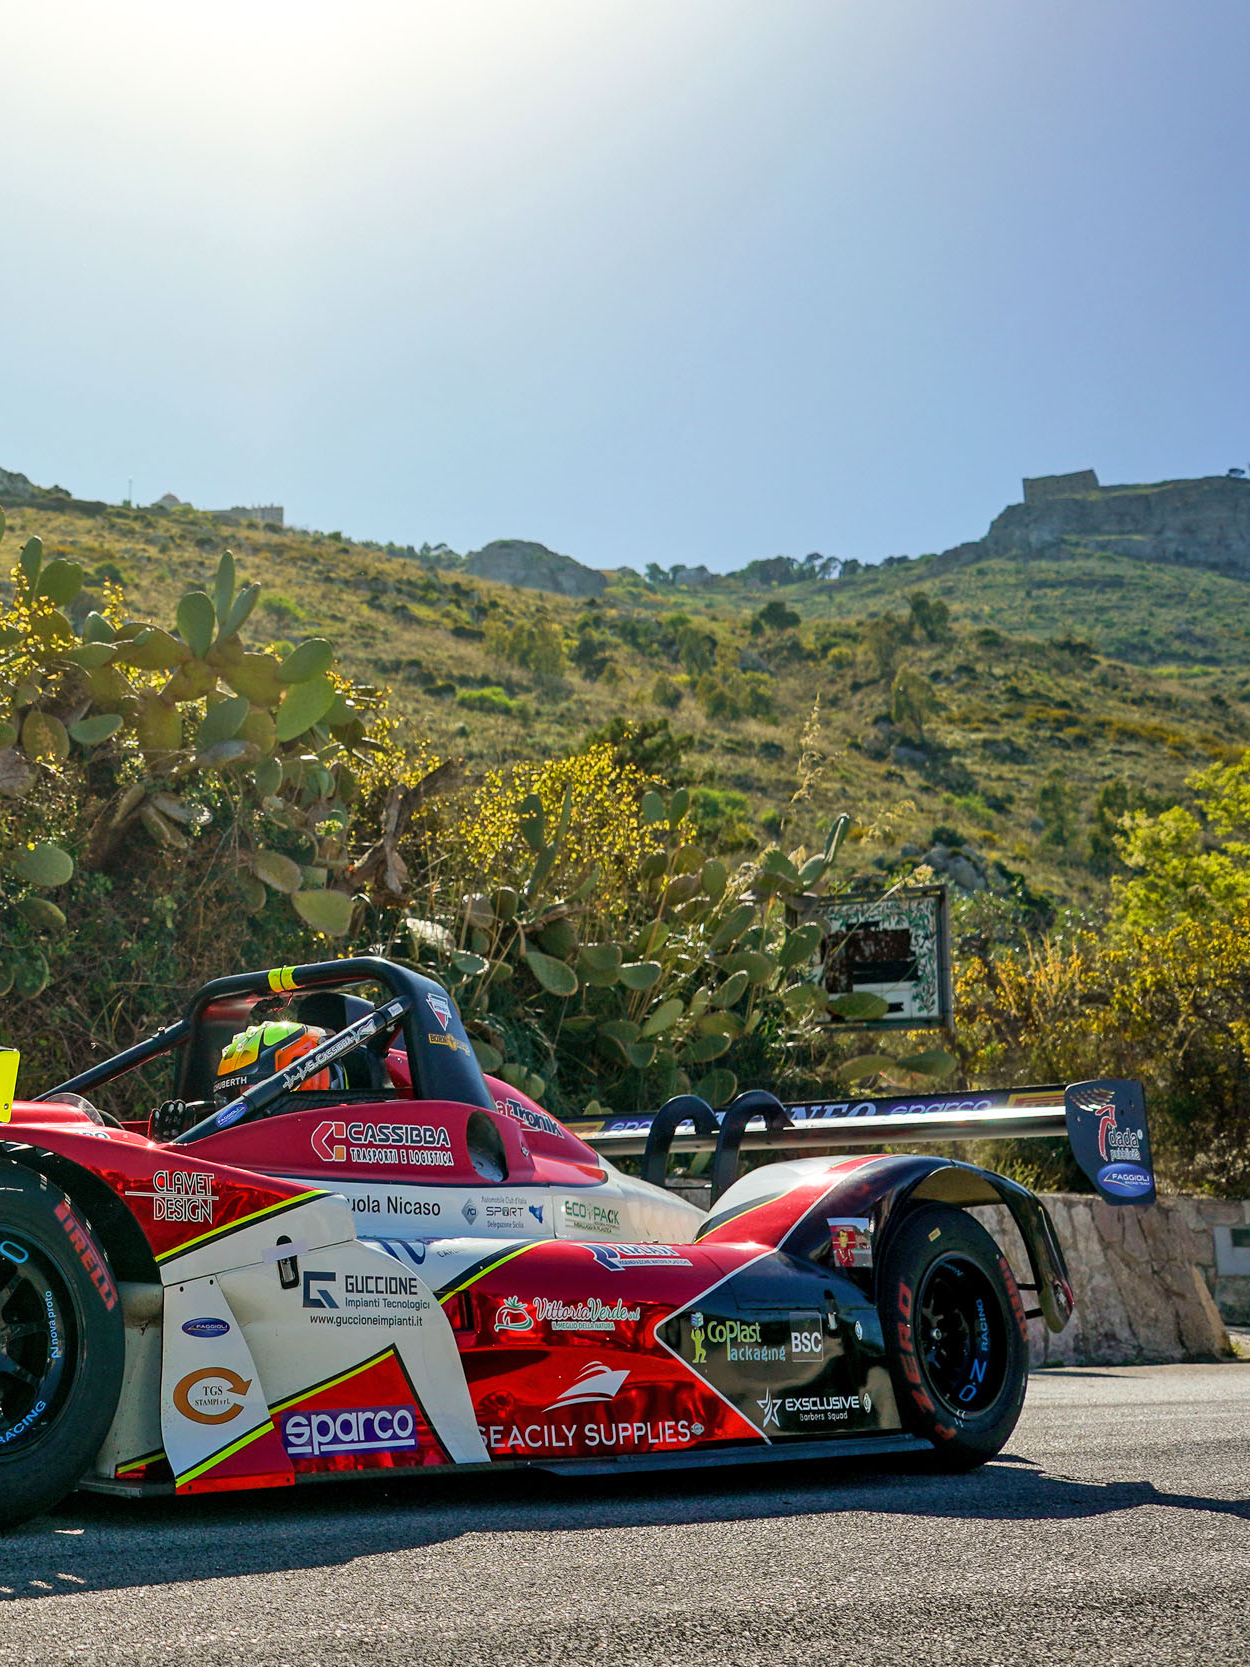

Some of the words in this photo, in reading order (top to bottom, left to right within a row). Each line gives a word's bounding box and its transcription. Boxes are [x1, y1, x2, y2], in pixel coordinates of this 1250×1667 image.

[348, 1123, 451, 1147] CASSIBBA
[350, 1148, 398, 1164] TRASPORTI
[400, 1150, 407, 1164] E
[410, 1150, 454, 1166] LOGISTICA
[153, 1170, 215, 1195] CLAVET
[153, 1197, 213, 1224] DESIGN
[387, 1196, 441, 1216] Nicaso
[486, 1206, 524, 1217] SPORT
[53, 1200, 120, 1312] PIRELLI
[345, 1275, 418, 1295] GUCCIONE
[45, 1290, 57, 1318] proto
[345, 1297, 380, 1309] Impianti
[383, 1298, 430, 1311] Tecnologici
[310, 1315, 423, 1328] www.guccioneimpianti.it
[976, 1299, 989, 1351] RACING
[791, 1332, 822, 1353] BSC
[203, 1385, 223, 1397] TGS
[786, 1396, 860, 1411] EXSCLUSIVE
[800, 1412, 825, 1422] Barbers
[827, 1411, 848, 1421] Squad
[286, 1408, 414, 1455] sparco
[584, 1420, 691, 1446] SUPPLIES
